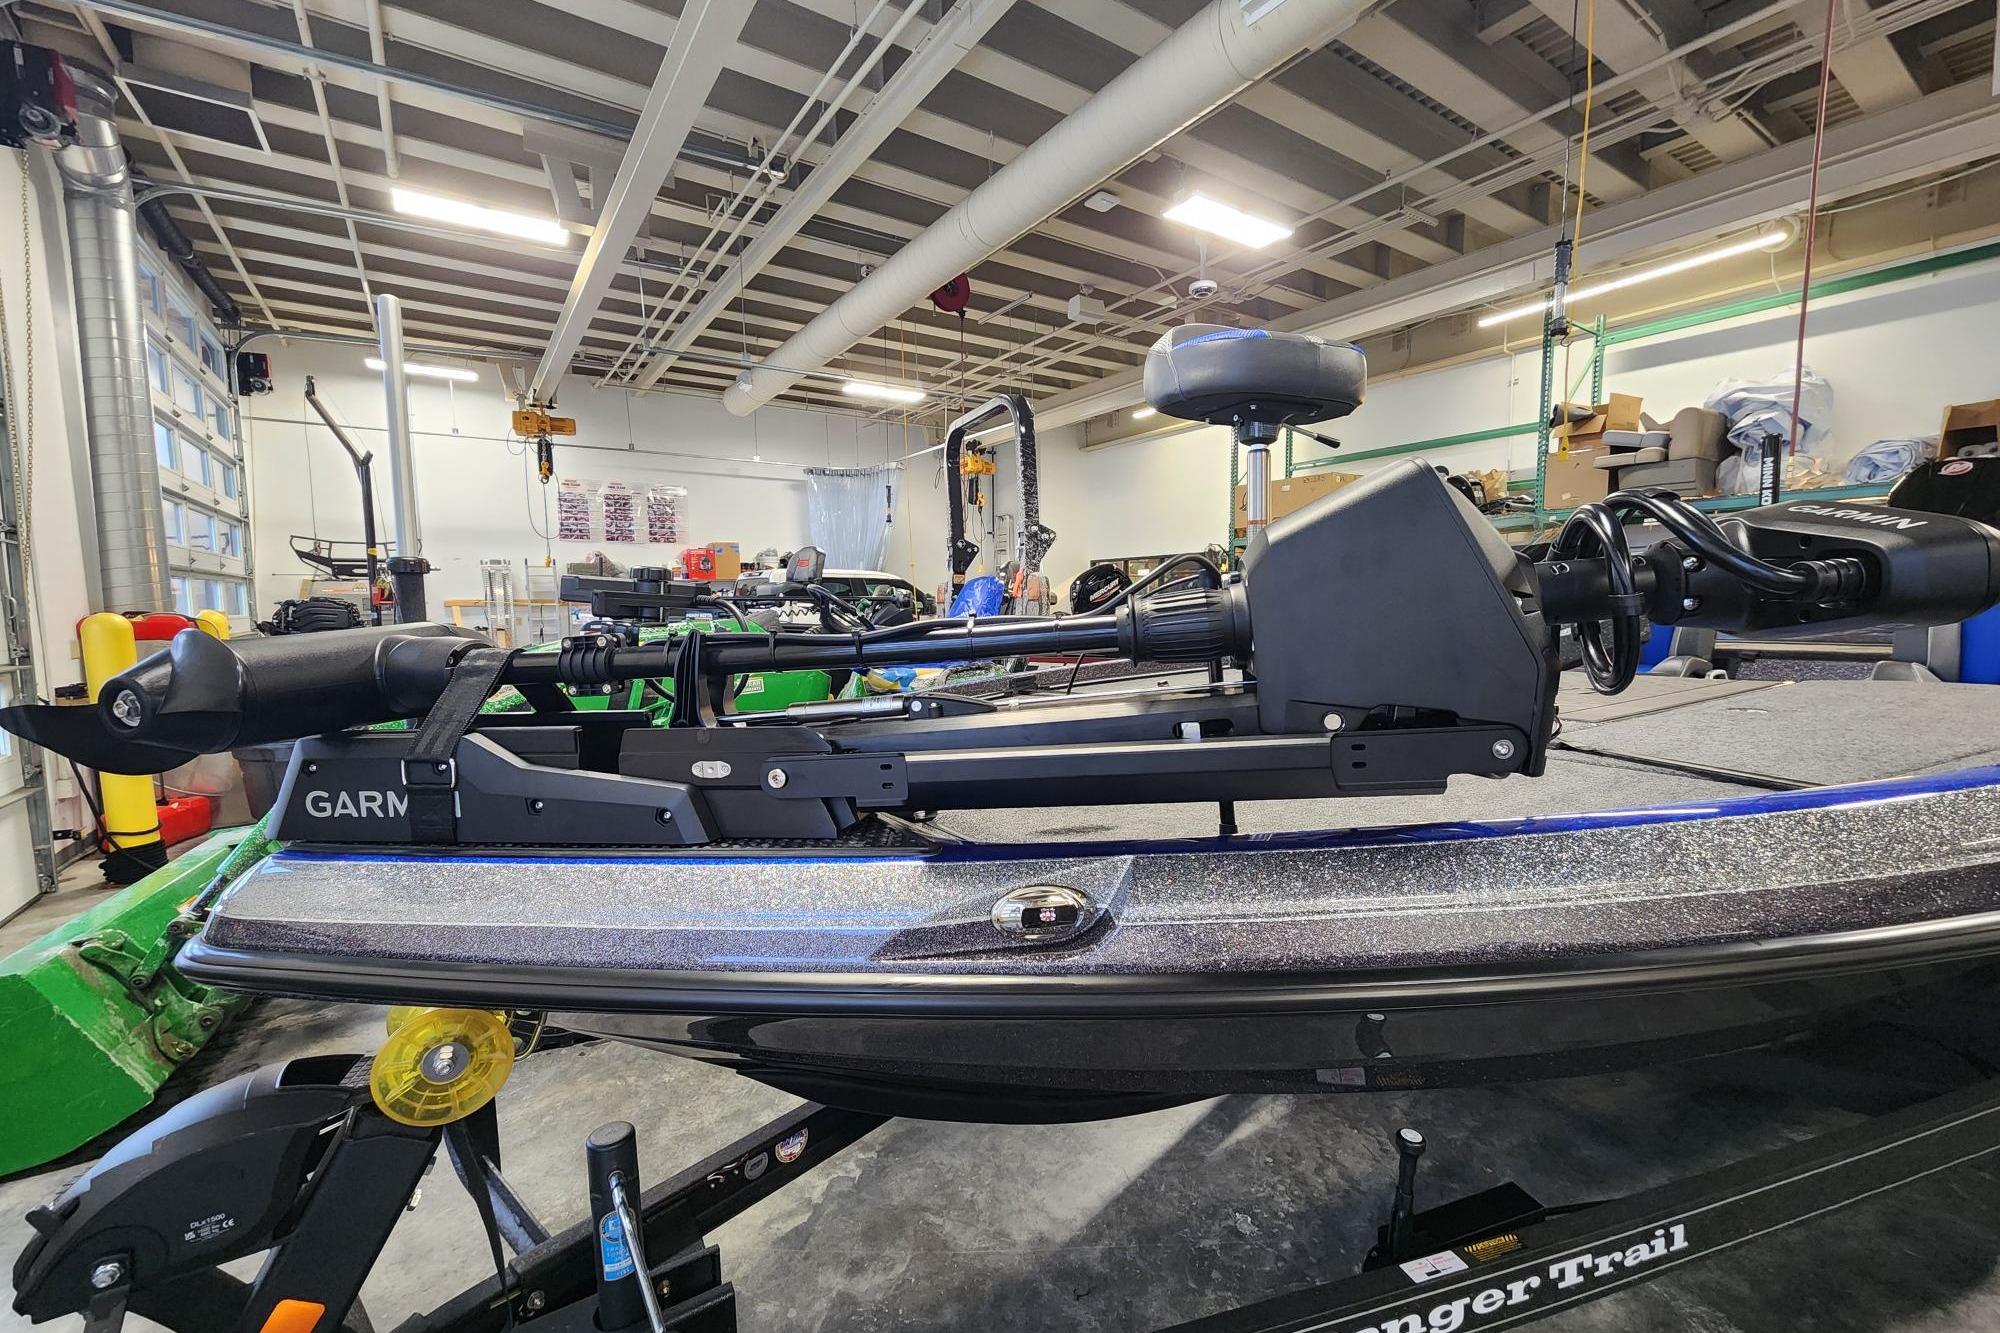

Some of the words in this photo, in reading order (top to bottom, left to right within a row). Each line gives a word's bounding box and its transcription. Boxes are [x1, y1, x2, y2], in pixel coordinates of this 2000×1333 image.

[1762, 457, 1774, 488] MINN
[1787, 505, 1929, 530] GARMIN
[1089, 577, 1119, 602] MERCURY
[305, 790, 462, 818] GARM
[1549, 1223, 1689, 1289] Trail
